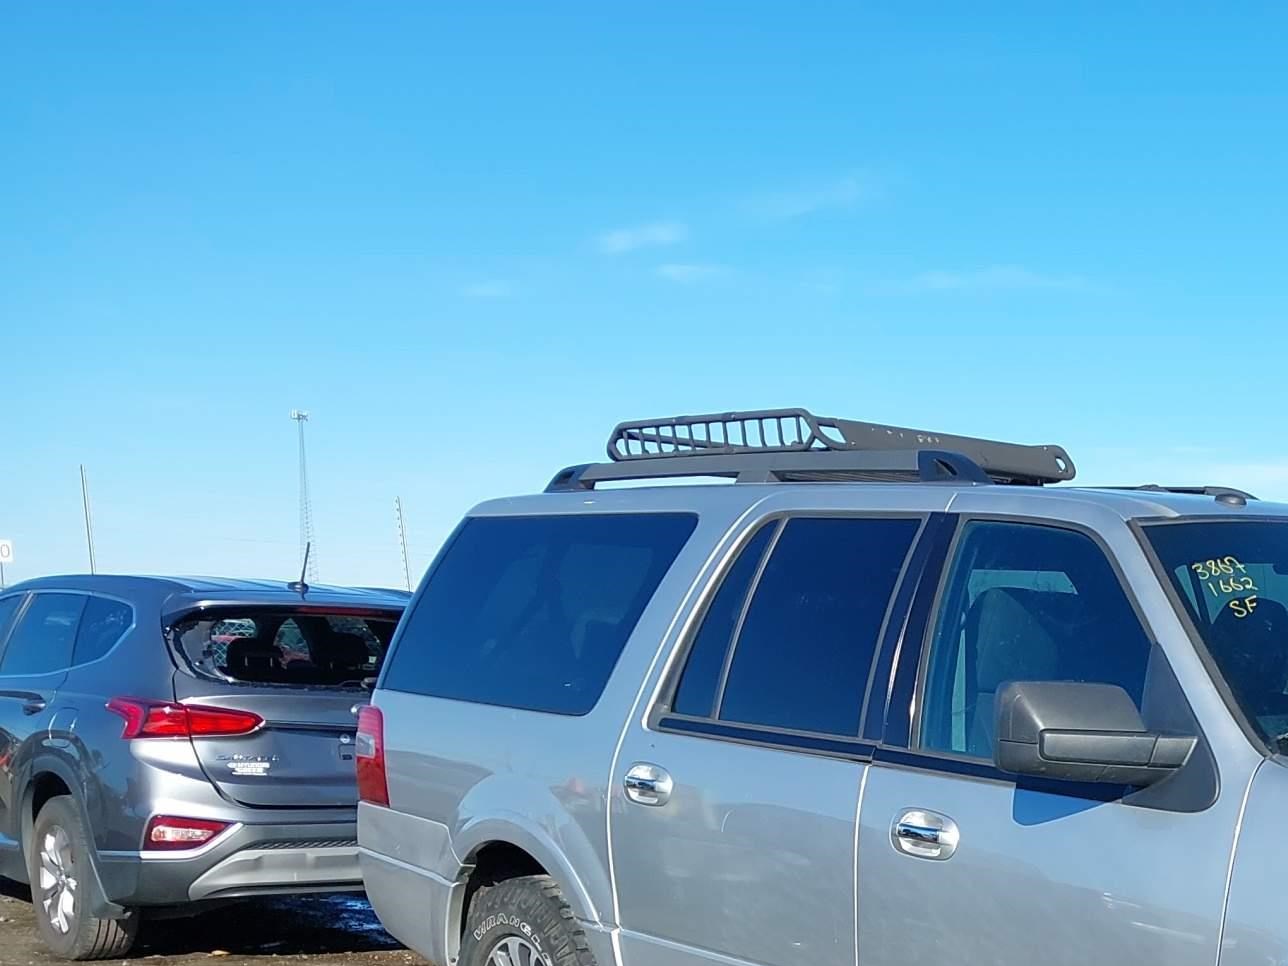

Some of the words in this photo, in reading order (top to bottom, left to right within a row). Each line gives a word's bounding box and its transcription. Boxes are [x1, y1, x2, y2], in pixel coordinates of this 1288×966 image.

[1192, 556, 1247, 580] 3867
[1208, 577, 1259, 597] 1662
[1229, 595, 1257, 618] SF
